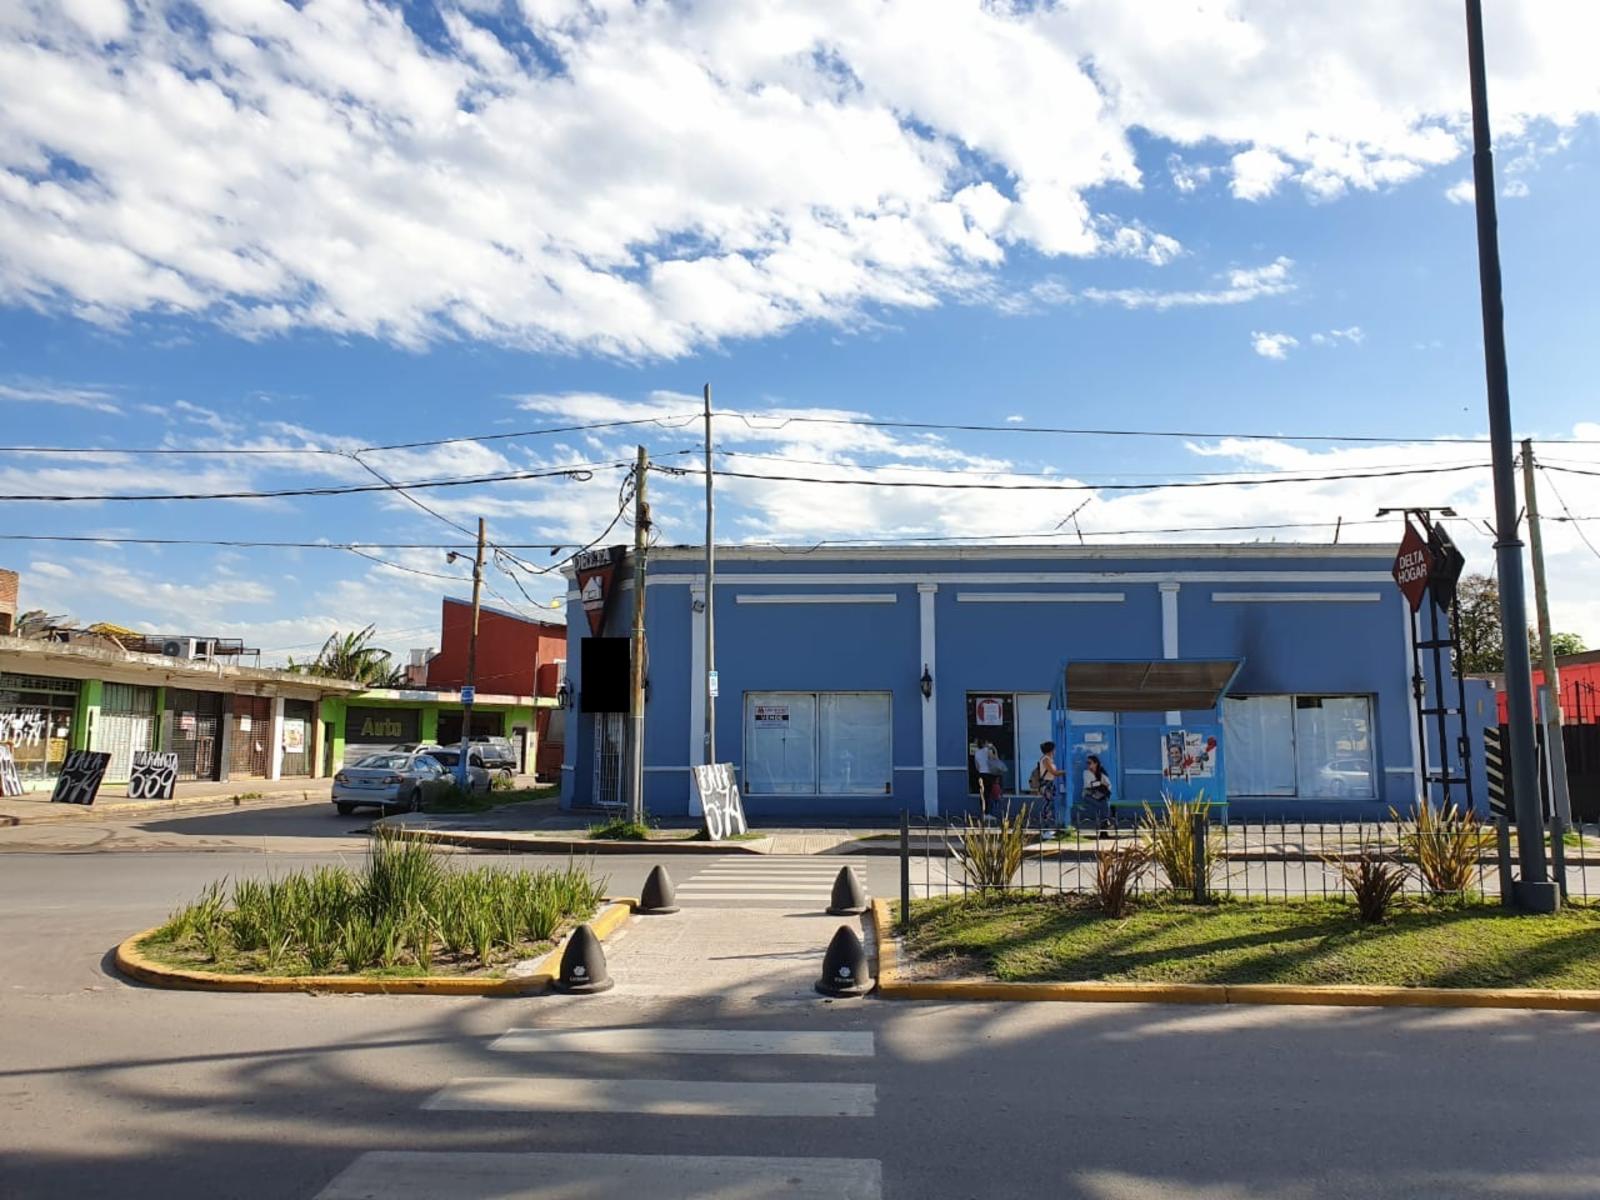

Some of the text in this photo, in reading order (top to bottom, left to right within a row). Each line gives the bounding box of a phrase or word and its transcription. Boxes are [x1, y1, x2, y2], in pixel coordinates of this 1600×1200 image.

[1399, 550, 1424, 570] DELTA
[1398, 563, 1427, 584] HOGAR
[360, 717, 402, 737] Auto
